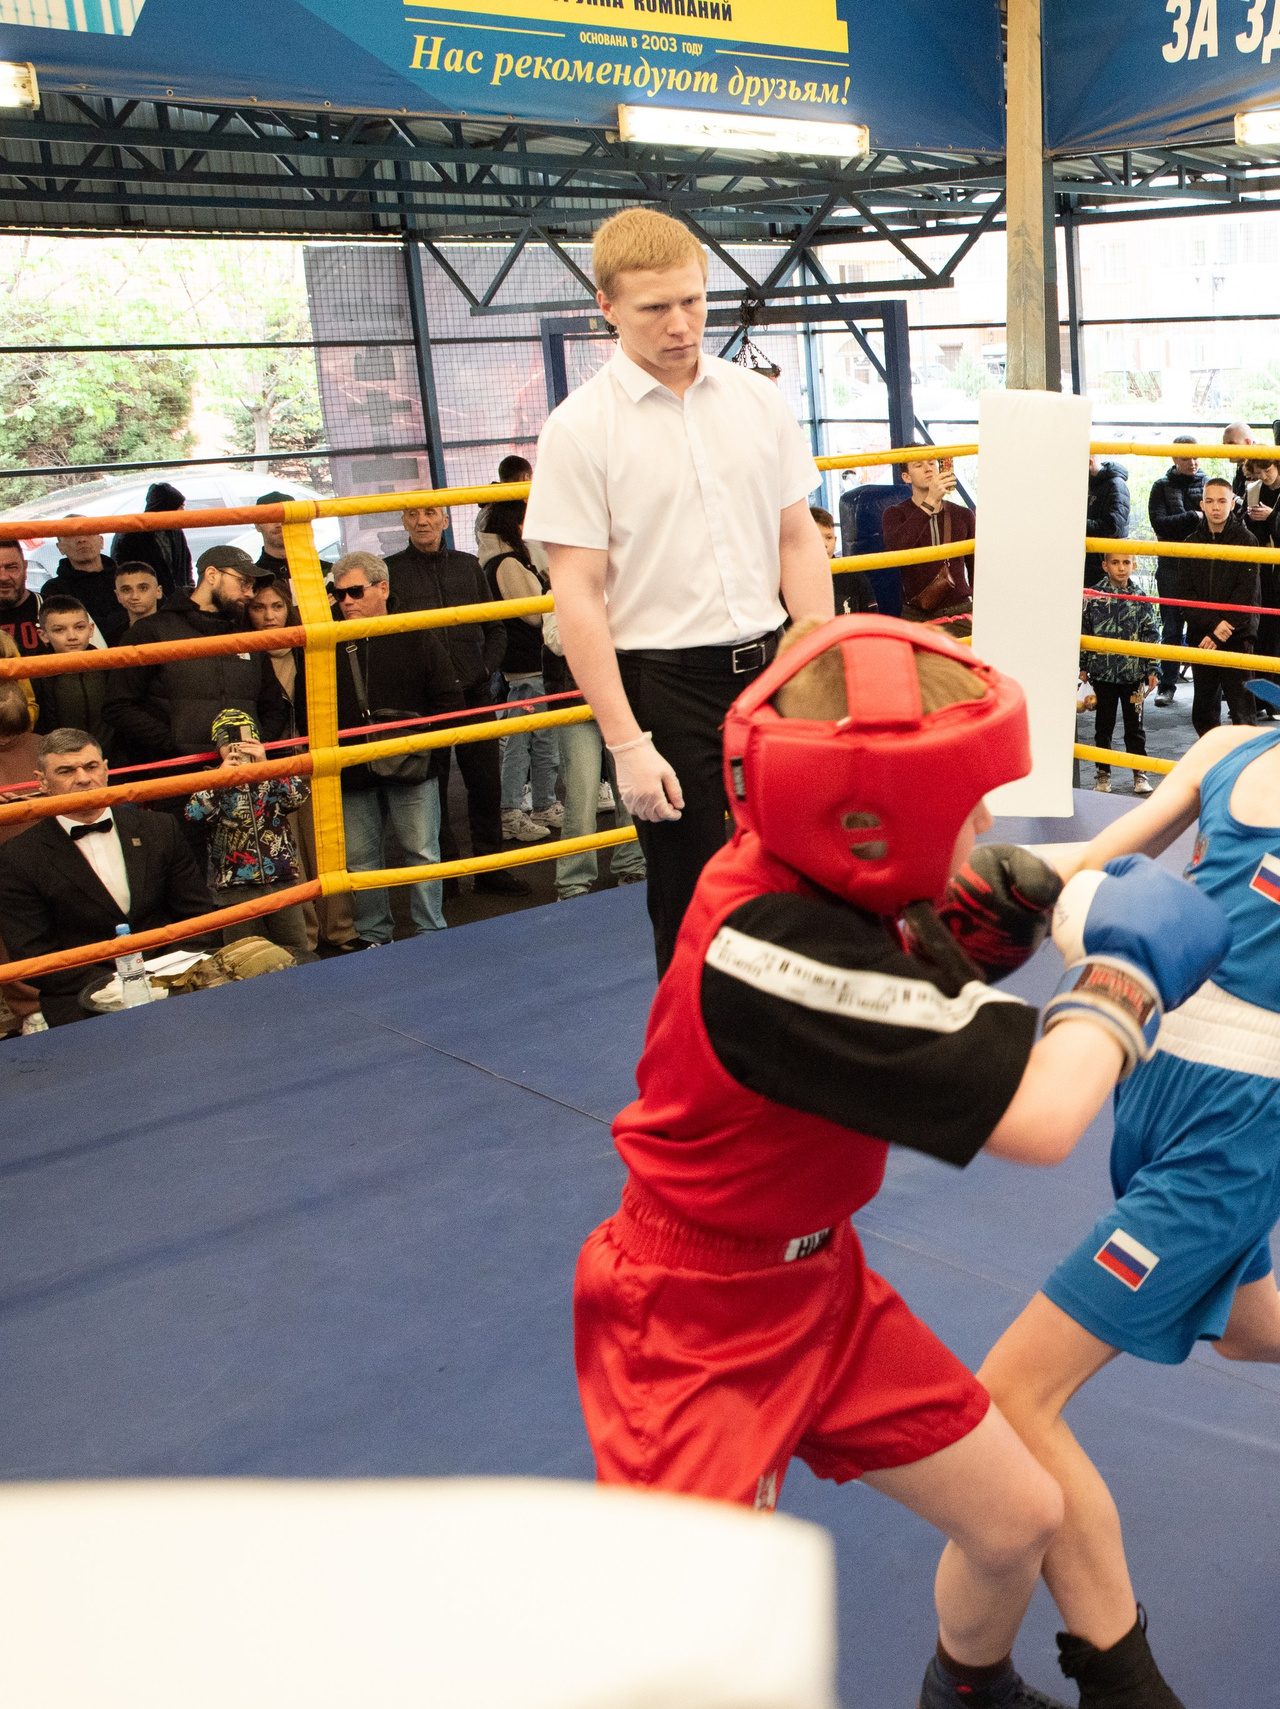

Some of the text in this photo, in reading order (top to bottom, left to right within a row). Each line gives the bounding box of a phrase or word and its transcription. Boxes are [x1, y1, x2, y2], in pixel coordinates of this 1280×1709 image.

[579, 31, 703, 56] ОСНОВАНА В 2003 ГОДУ
[1162, 0, 1219, 63] ЗА
[409, 34, 850, 106] Нас рекомендуют друзьям!
